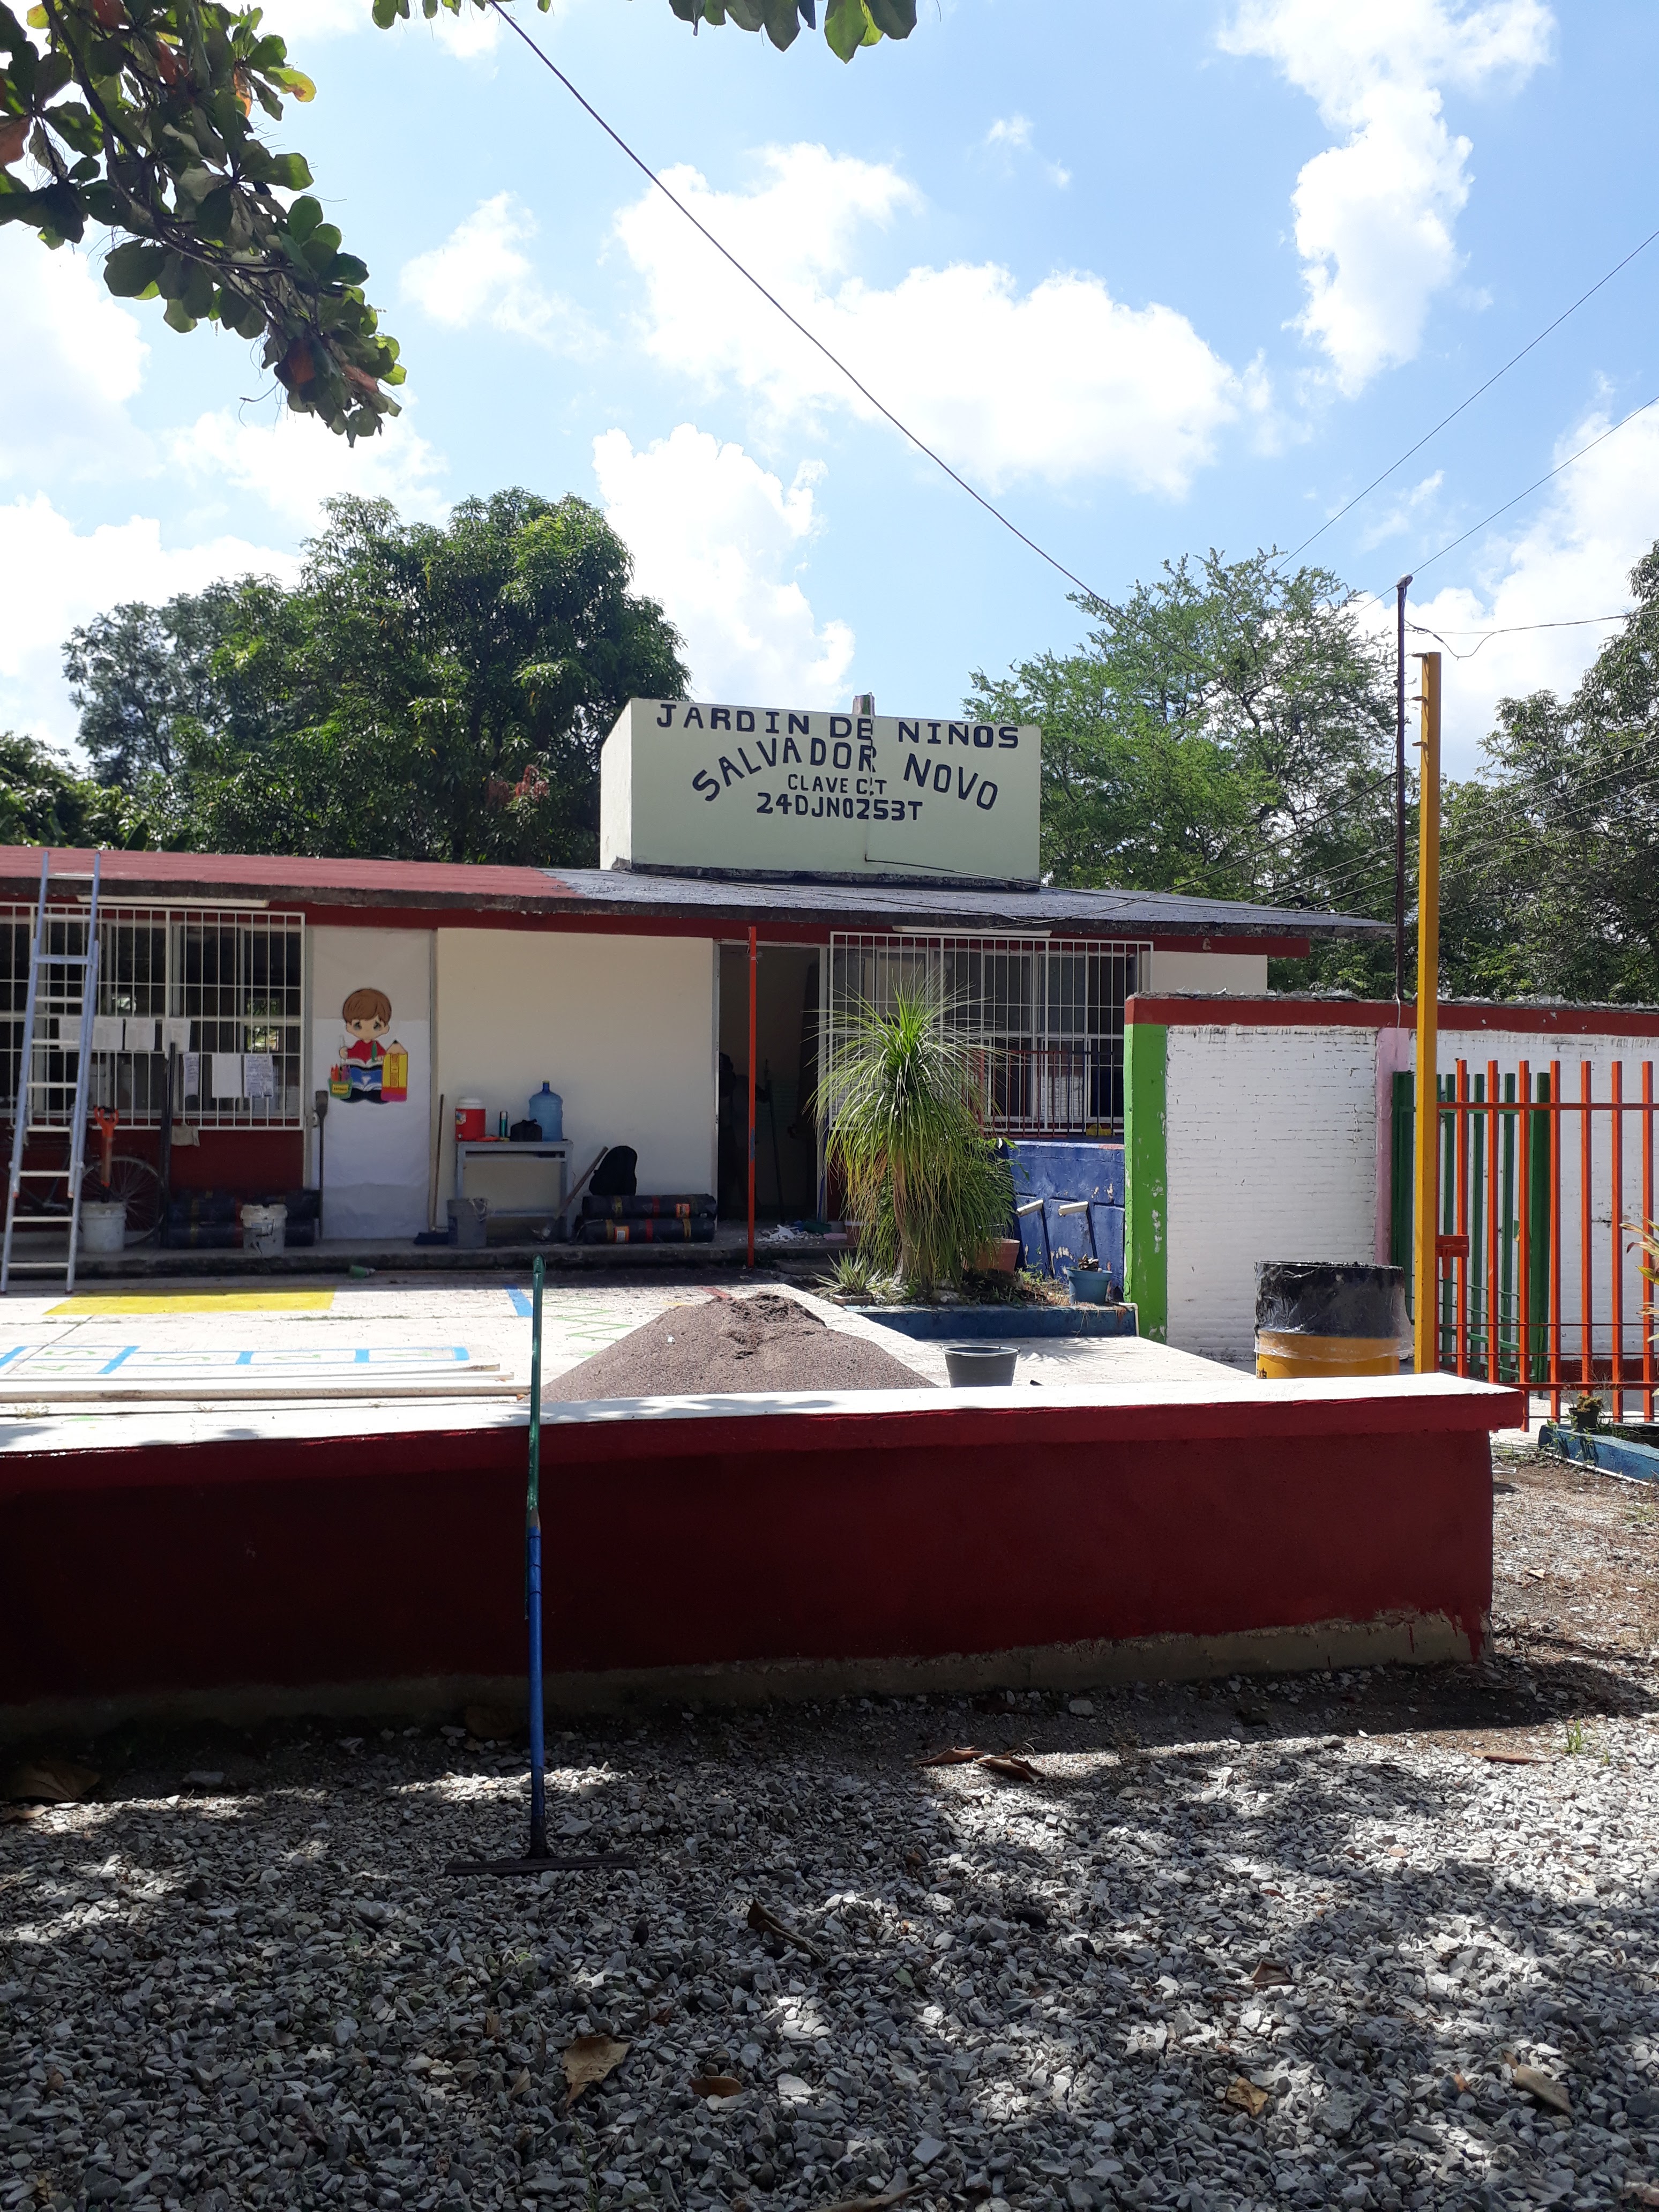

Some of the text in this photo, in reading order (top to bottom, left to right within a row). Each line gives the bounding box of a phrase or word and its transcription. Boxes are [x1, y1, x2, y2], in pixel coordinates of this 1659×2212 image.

[656, 703, 1019, 749] JARDIN DE NIÑOS
[692, 737, 998, 811] SALVADOR NOVO
[788, 774, 849, 794] CLAVE
[756, 792, 923, 821] 24DJN0253T
